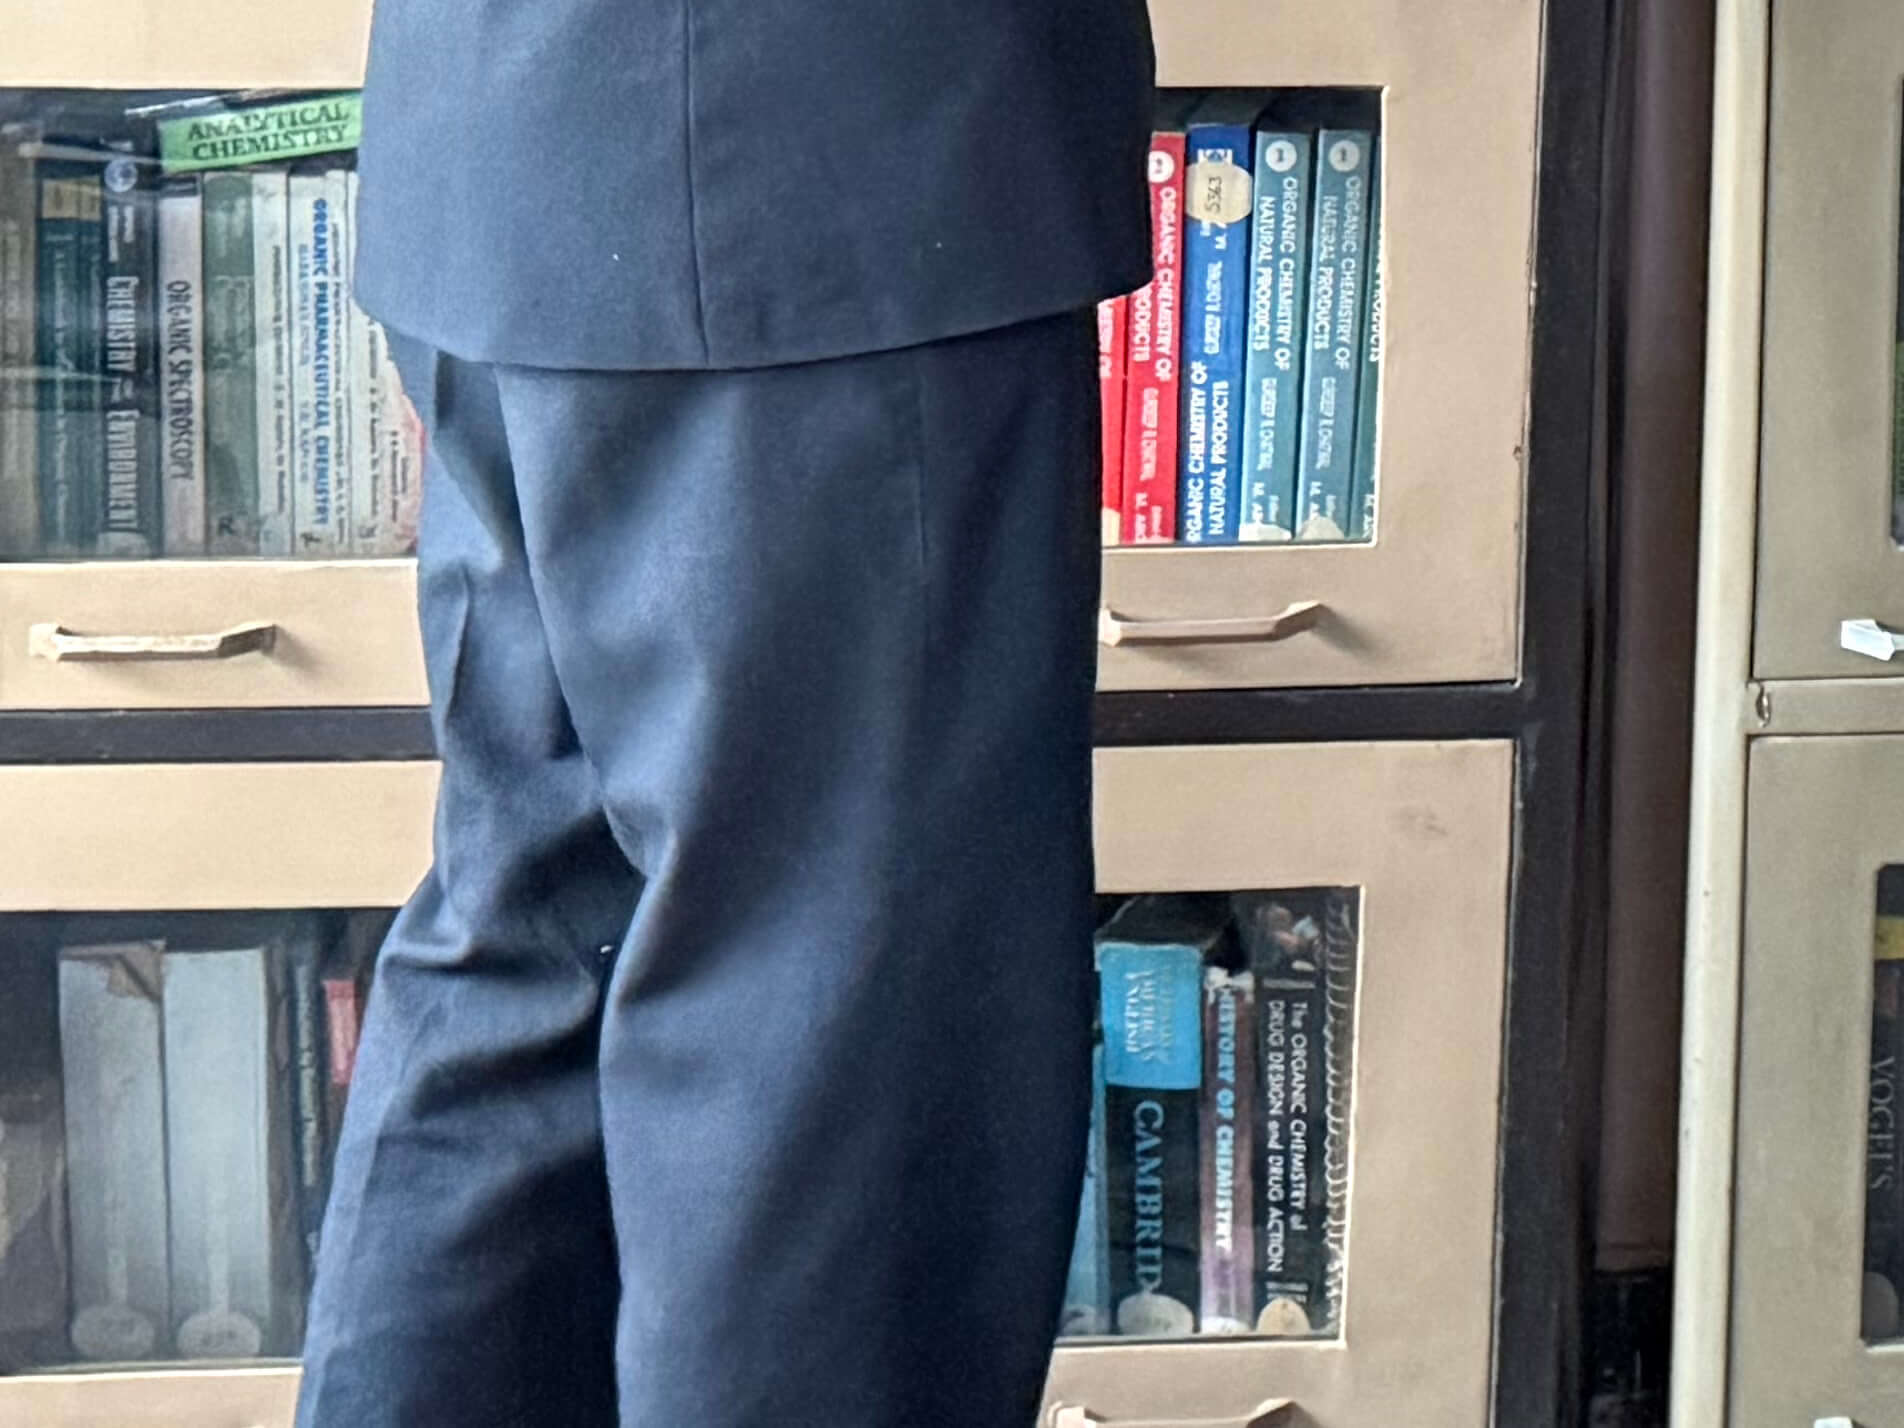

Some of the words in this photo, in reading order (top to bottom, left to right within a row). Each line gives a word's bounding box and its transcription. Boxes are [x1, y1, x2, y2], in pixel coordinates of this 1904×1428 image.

[185, 102, 350, 142] ANALYTICAL
[192, 126, 348, 161] CHEMISTRY
[1157, 186, 1176, 264] ORGANIC
[1258, 195, 1275, 263] NATURAL
[1281, 176, 1297, 253] ORGANIC
[1344, 176, 1361, 253] ORGANIC
[106, 276, 139, 372] CHEMISTRY
[165, 280, 190, 358] ORGANIC
[1154, 268, 1175, 355] CHEMISTRY
[1313, 266, 1335, 350] PRODUCTS
[1339, 257, 1359, 343] CHEMISTRY
[1155, 358, 1173, 382] OF
[1274, 348, 1291, 371] OF
[1336, 347, 1352, 370] OF
[165, 359, 195, 482] SPECTROSCOPY
[1269, 1000, 1286, 1046] DRUG
[1216, 1089, 1236, 1120] OF
[1268, 1051, 1284, 1116] DESIGN
[1290, 1033, 1308, 1114] ORGANIC
[1214, 1122, 1235, 1249] CHEMISTRY
[1267, 1154, 1284, 1202] DRUG
[1267, 1206, 1284, 1272] ACTION
